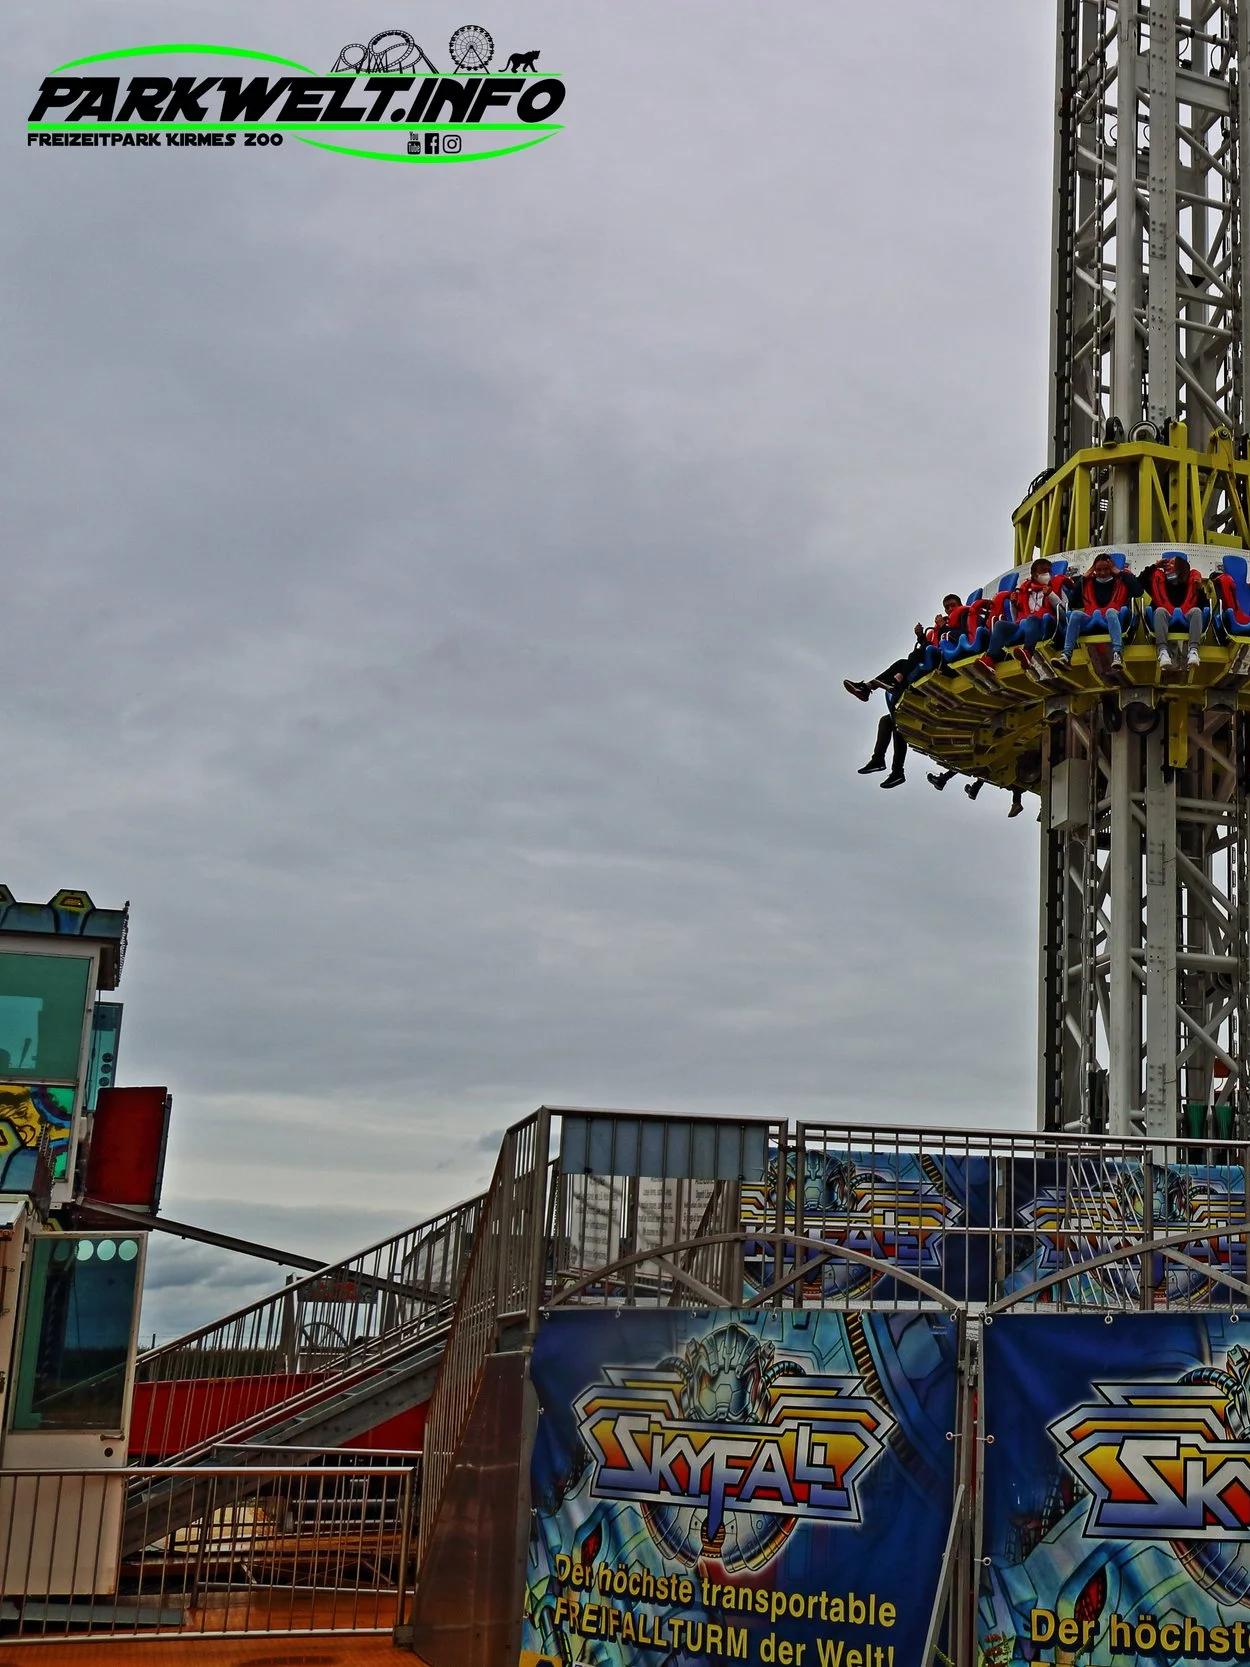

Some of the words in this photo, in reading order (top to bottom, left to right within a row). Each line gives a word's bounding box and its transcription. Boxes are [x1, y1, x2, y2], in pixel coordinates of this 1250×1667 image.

[596, 1412, 852, 1541] SKYFALL
[555, 1553, 592, 1587] Der
[599, 1561, 693, 1603] höchste
[702, 1577, 897, 1627] transportable
[553, 1597, 748, 1659] FREIFALLTURM
[760, 1631, 806, 1666] der
[1030, 1609, 1095, 1645] Der
